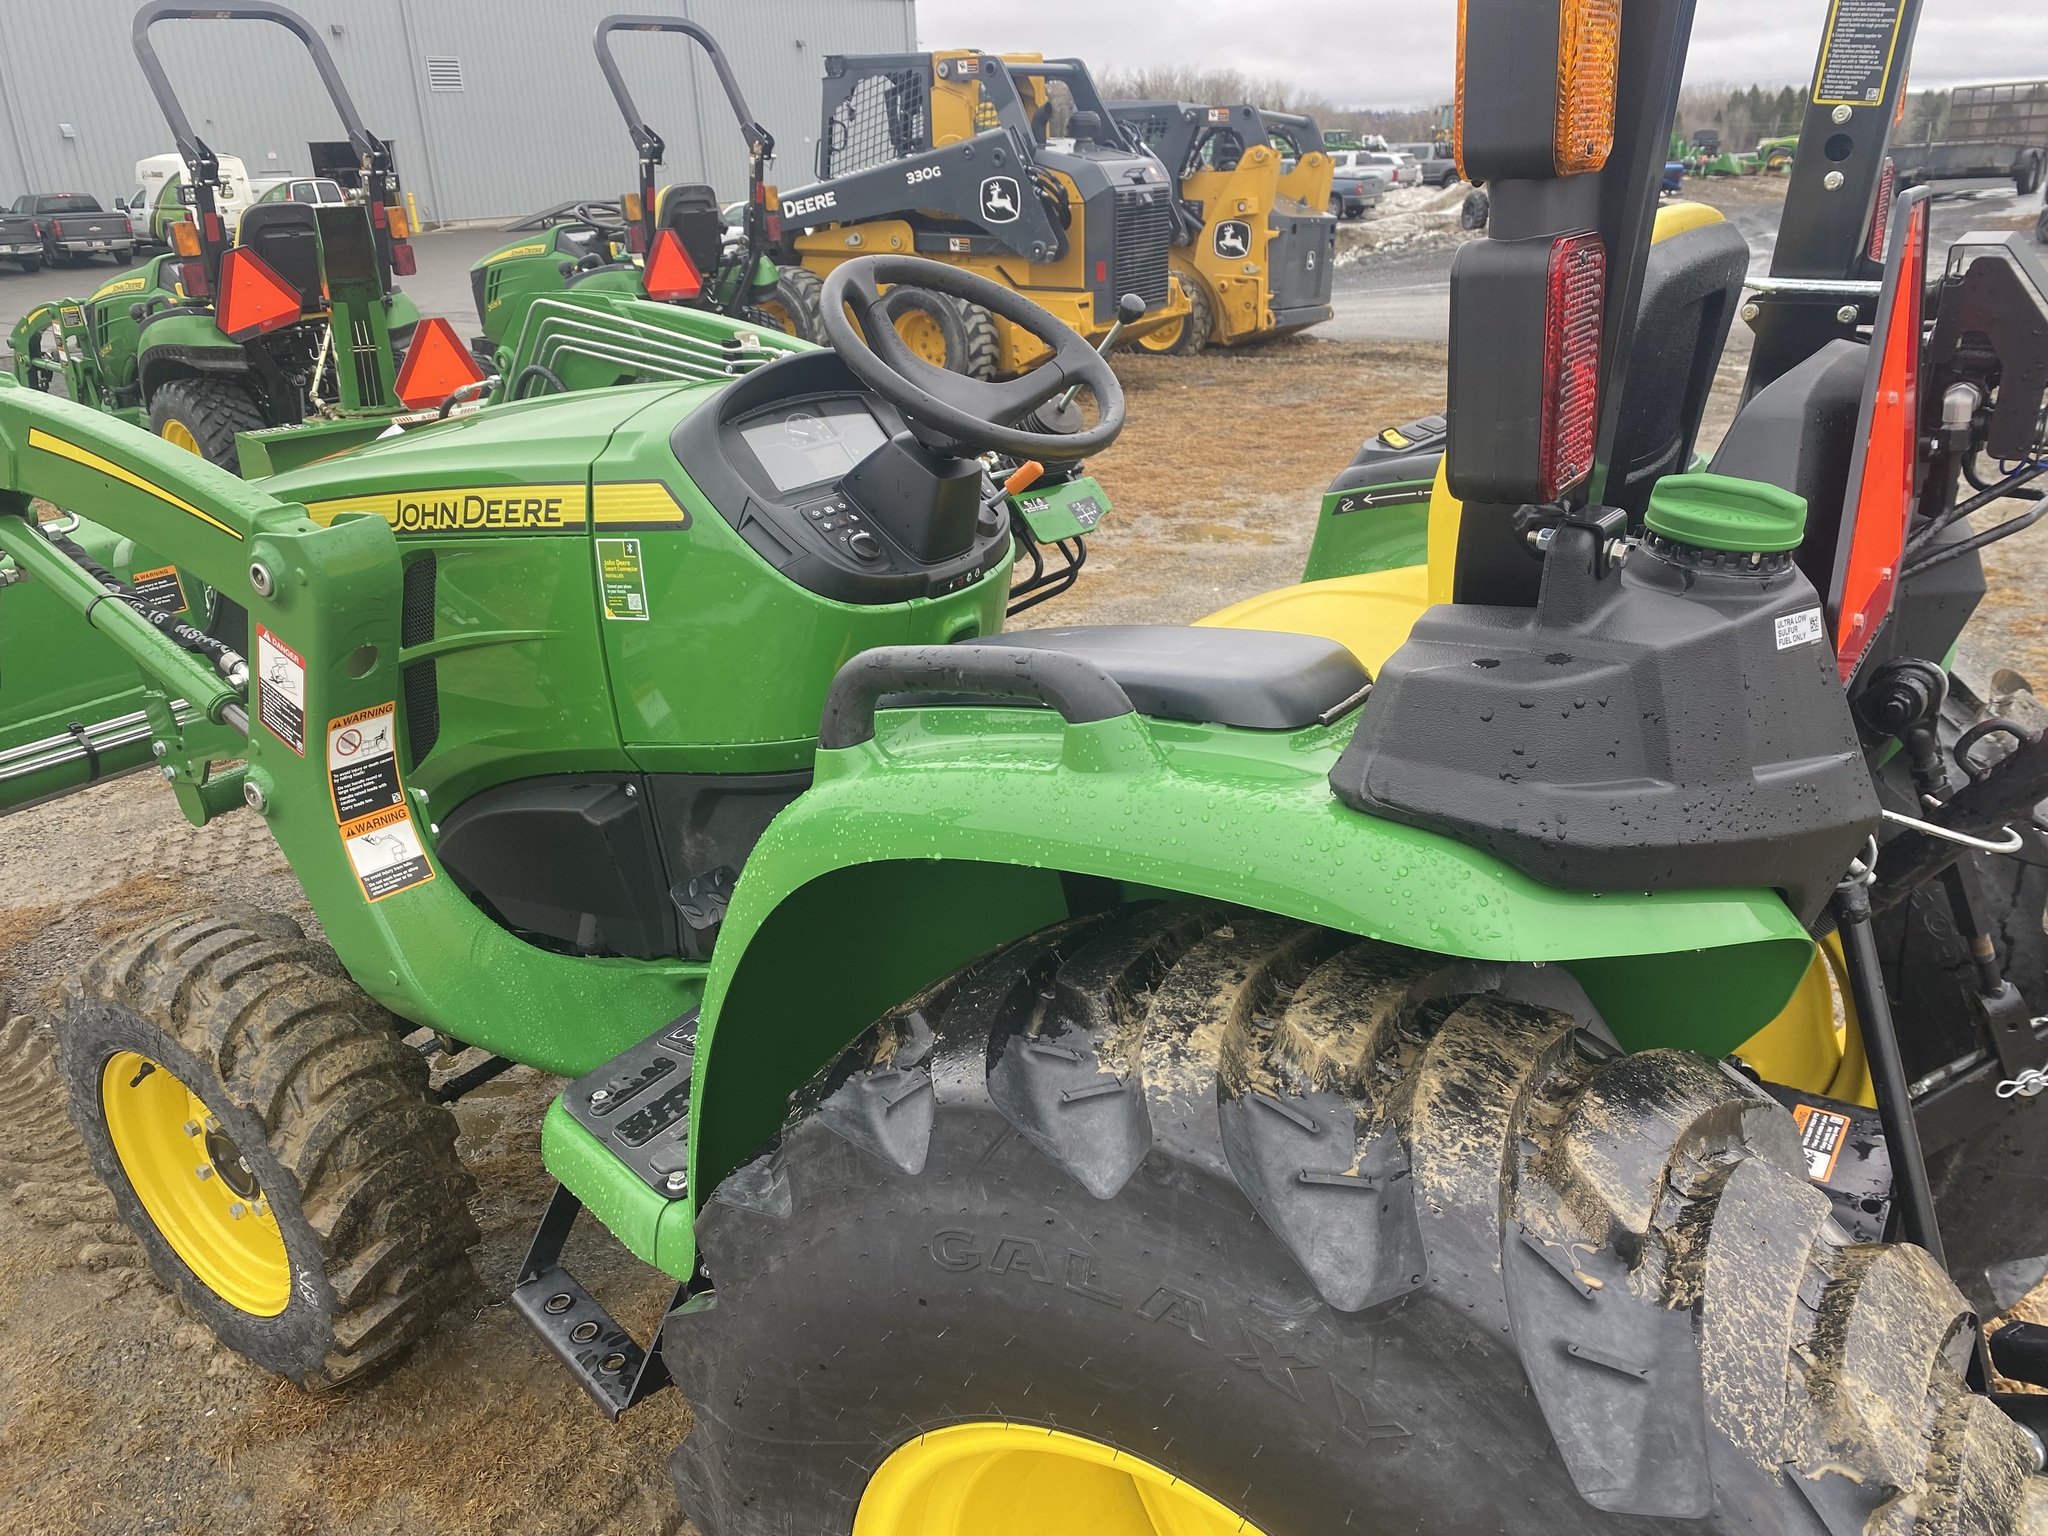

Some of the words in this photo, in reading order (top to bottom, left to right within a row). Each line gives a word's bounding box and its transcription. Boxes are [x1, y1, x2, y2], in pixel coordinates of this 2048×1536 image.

[906, 166, 942, 184] 330G
[782, 191, 837, 219] DEERE
[112, 282, 125, 292] JOHN
[125, 281, 142, 291] DEERE
[390, 499, 458, 528] JOHN
[463, 495, 563, 524] DEERE
[140, 568, 169, 580] WARNING
[1777, 618, 1794, 628] ULTRA
[1795, 614, 1807, 624] LOW
[1778, 626, 1798, 638] SULFUR
[1779, 637, 1792, 646] FUEL
[1792, 632, 1807, 642] ONLY
[272, 637, 300, 664] DANGER
[343, 704, 393, 726] WARNING
[355, 808, 406, 834] WARNING
[928, 1227, 1416, 1448] GALAXY
